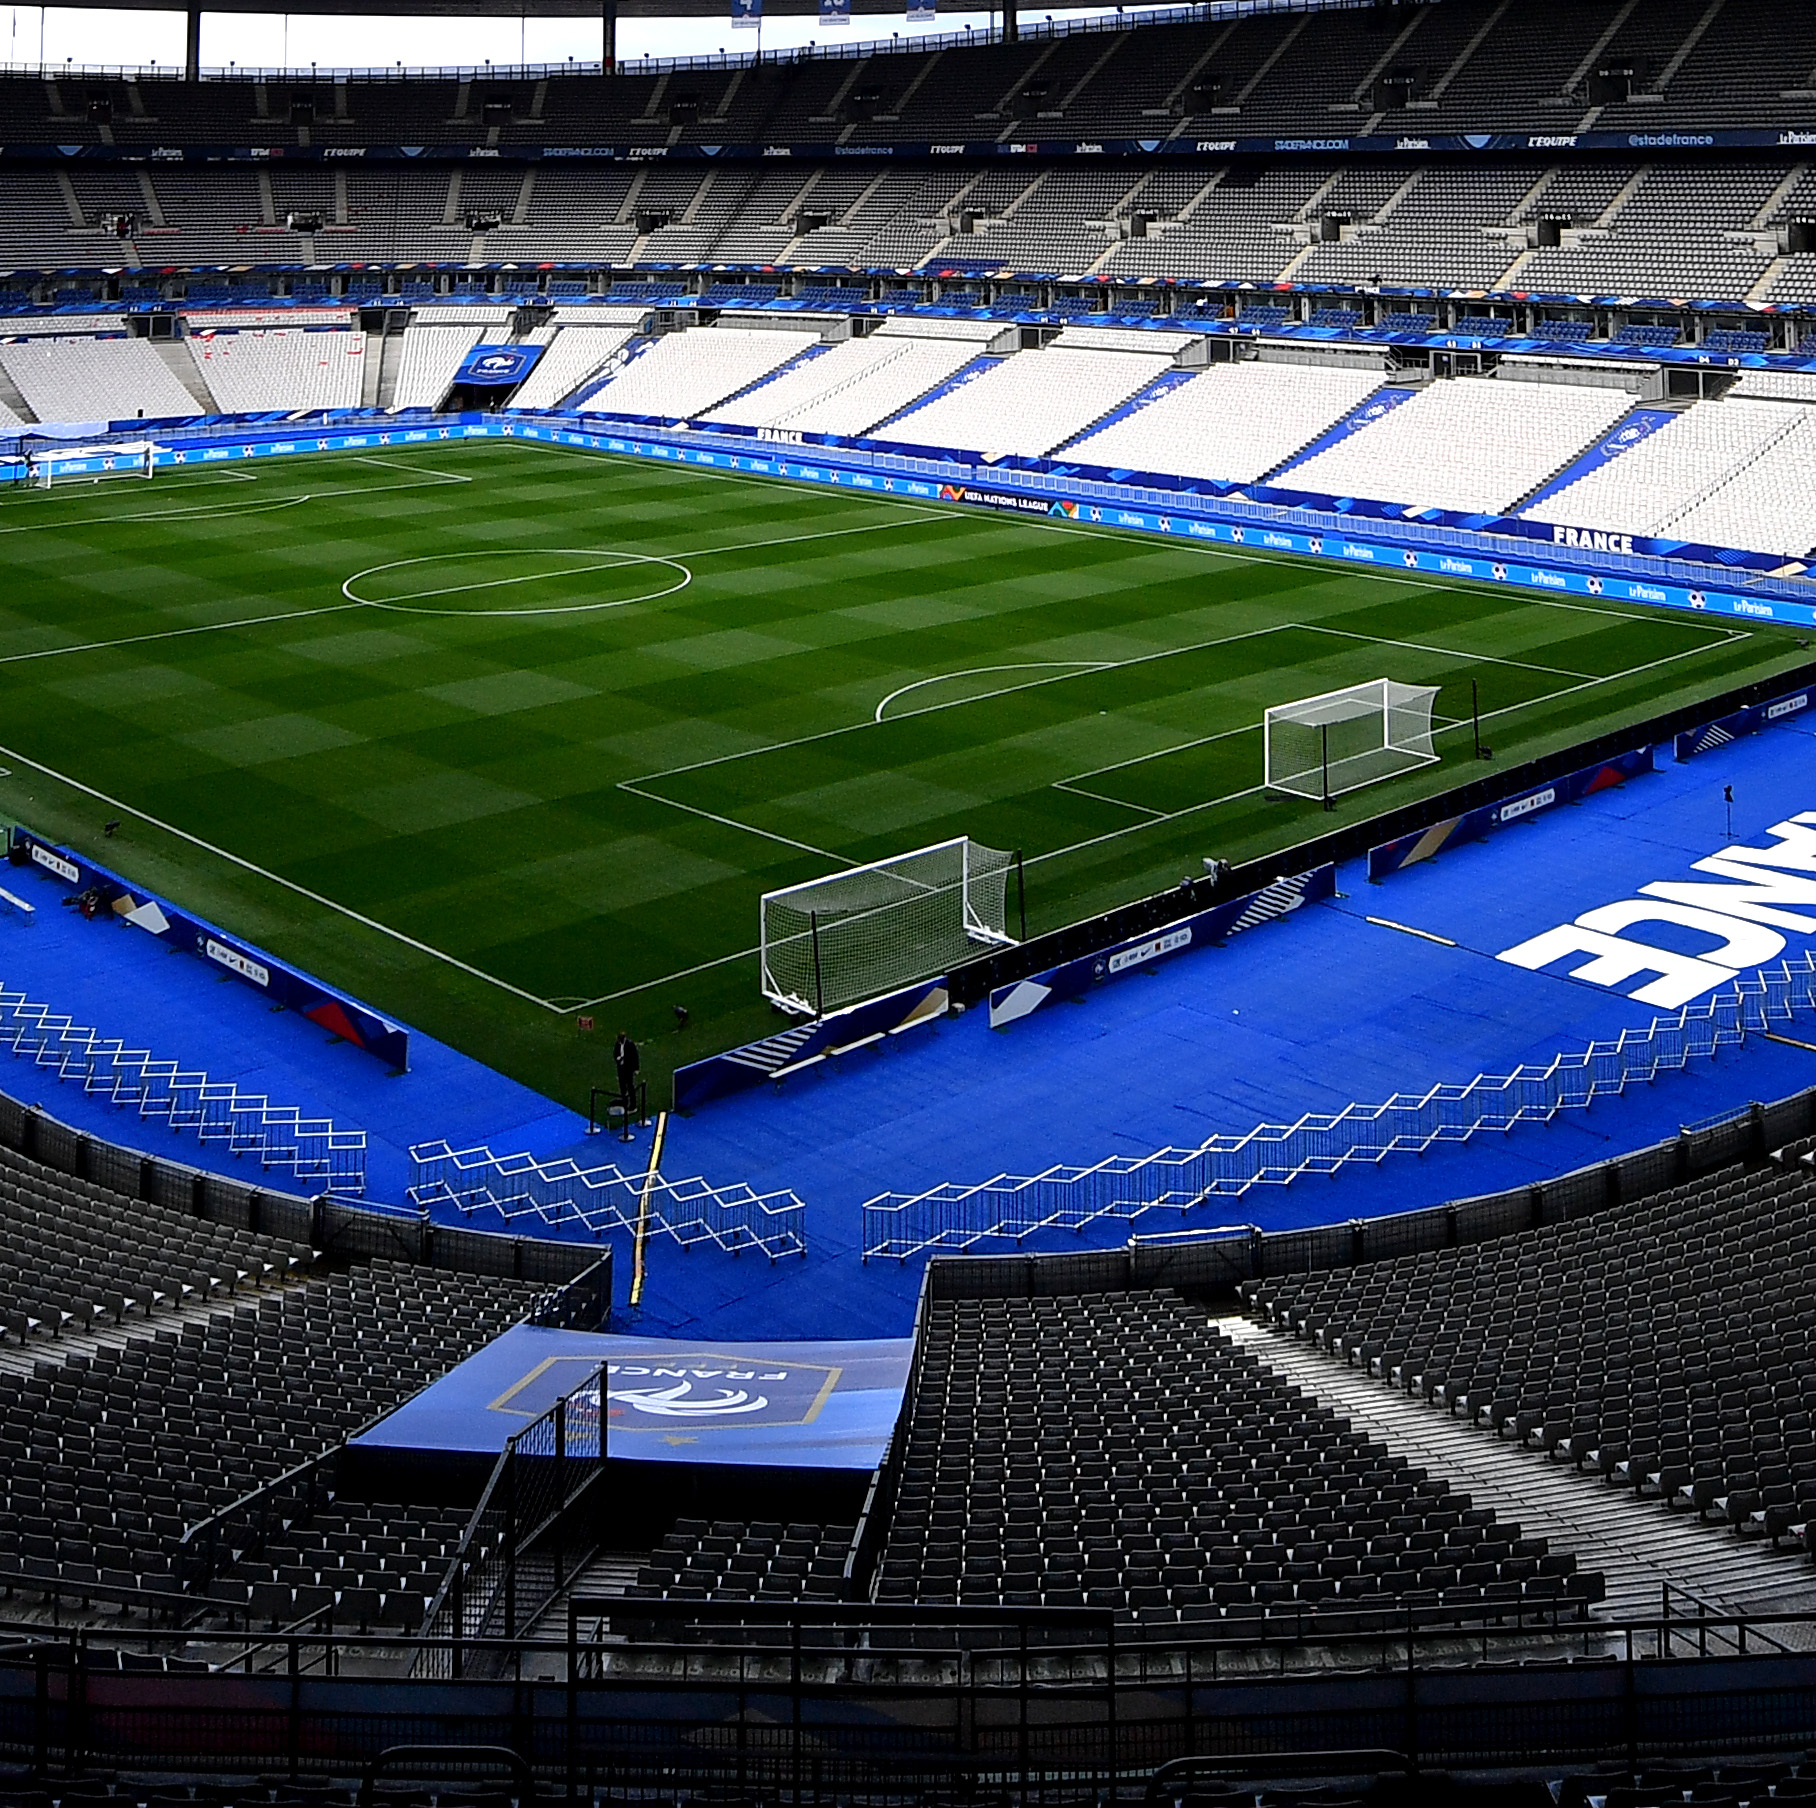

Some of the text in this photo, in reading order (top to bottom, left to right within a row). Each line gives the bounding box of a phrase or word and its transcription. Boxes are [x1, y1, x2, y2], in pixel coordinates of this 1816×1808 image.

[1628, 134, 1715, 146] @stadefrance
[756, 429, 803, 443] FRANCE
[964, 491, 1049, 512] UEFA NATIONS LEAGUE
[1554, 526, 1633, 555] FRANCE
[1629, 586, 1666, 601] Le Parisien
[1734, 601, 1773, 616] Le Parisien
[590, 1363, 789, 1383] FRANCE
